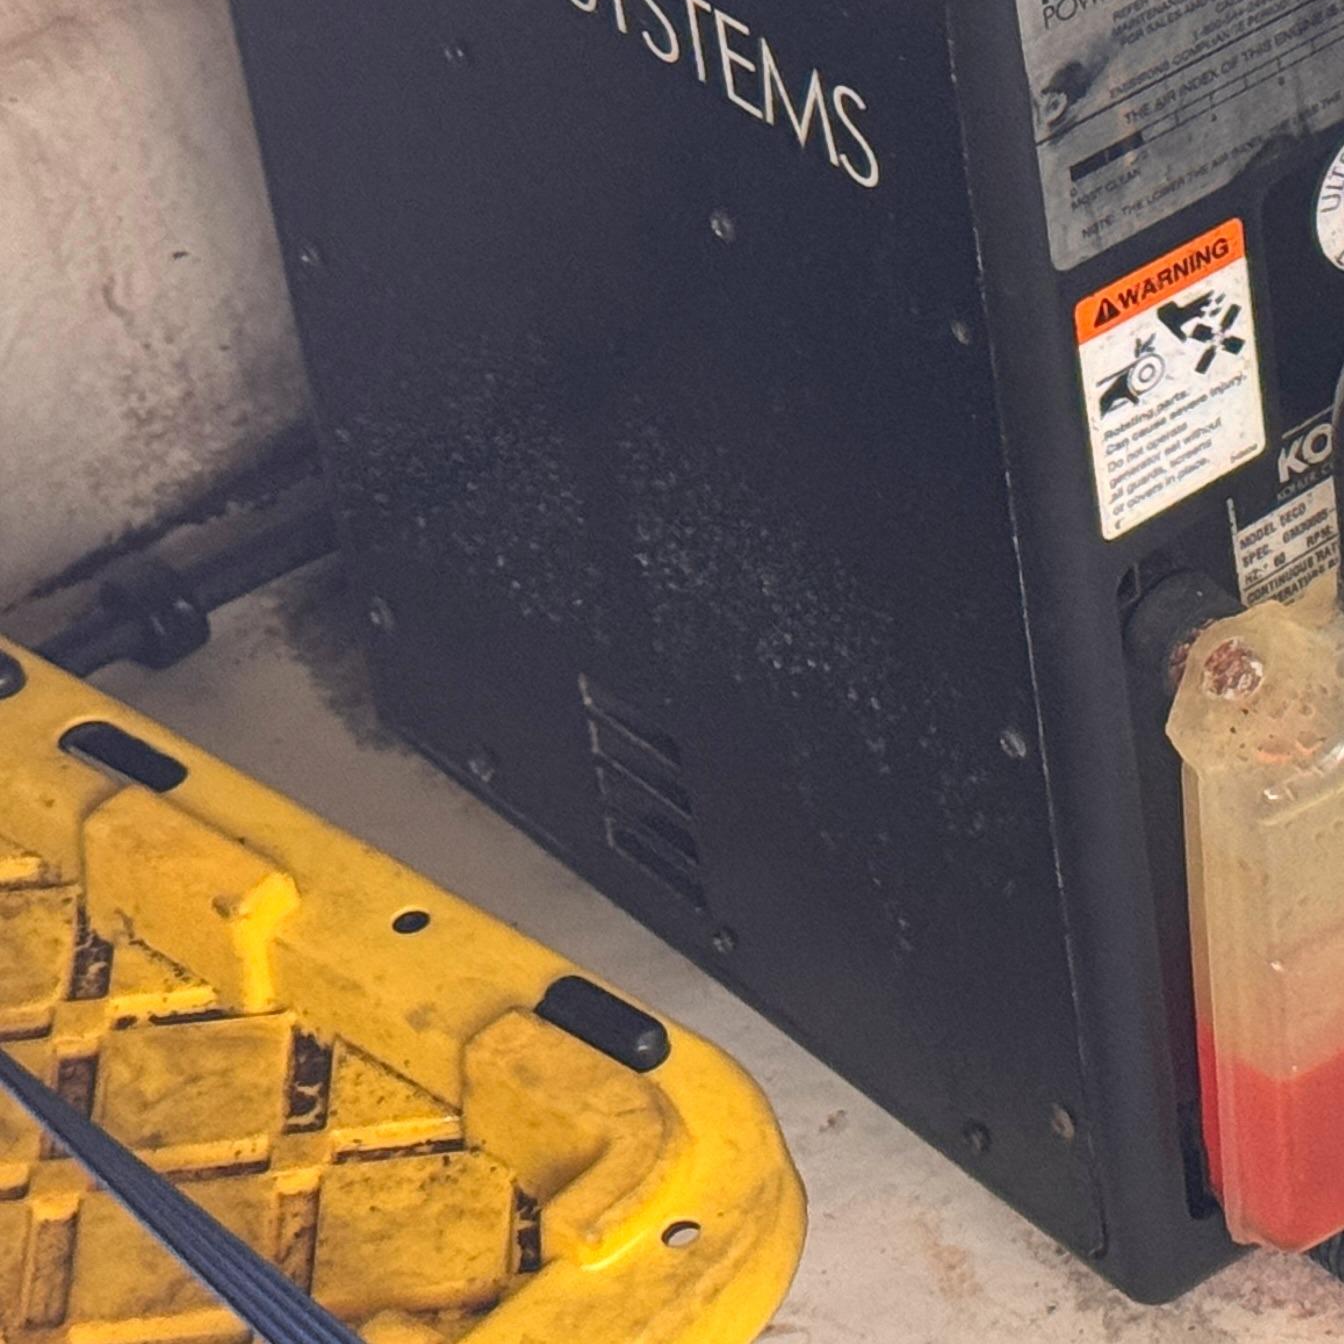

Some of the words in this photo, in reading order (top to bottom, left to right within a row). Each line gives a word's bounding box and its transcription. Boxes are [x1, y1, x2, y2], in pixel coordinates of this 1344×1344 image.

[1118, 238, 1230, 312] WARNING
[1105, 432, 1129, 458] Can
[1131, 413, 1166, 443] cause
[1169, 389, 1208, 422] severe
[1209, 366, 1247, 402] injury.
[1238, 522, 1278, 550] MODEL
[1246, 556, 1315, 604] CONTINUOUS
